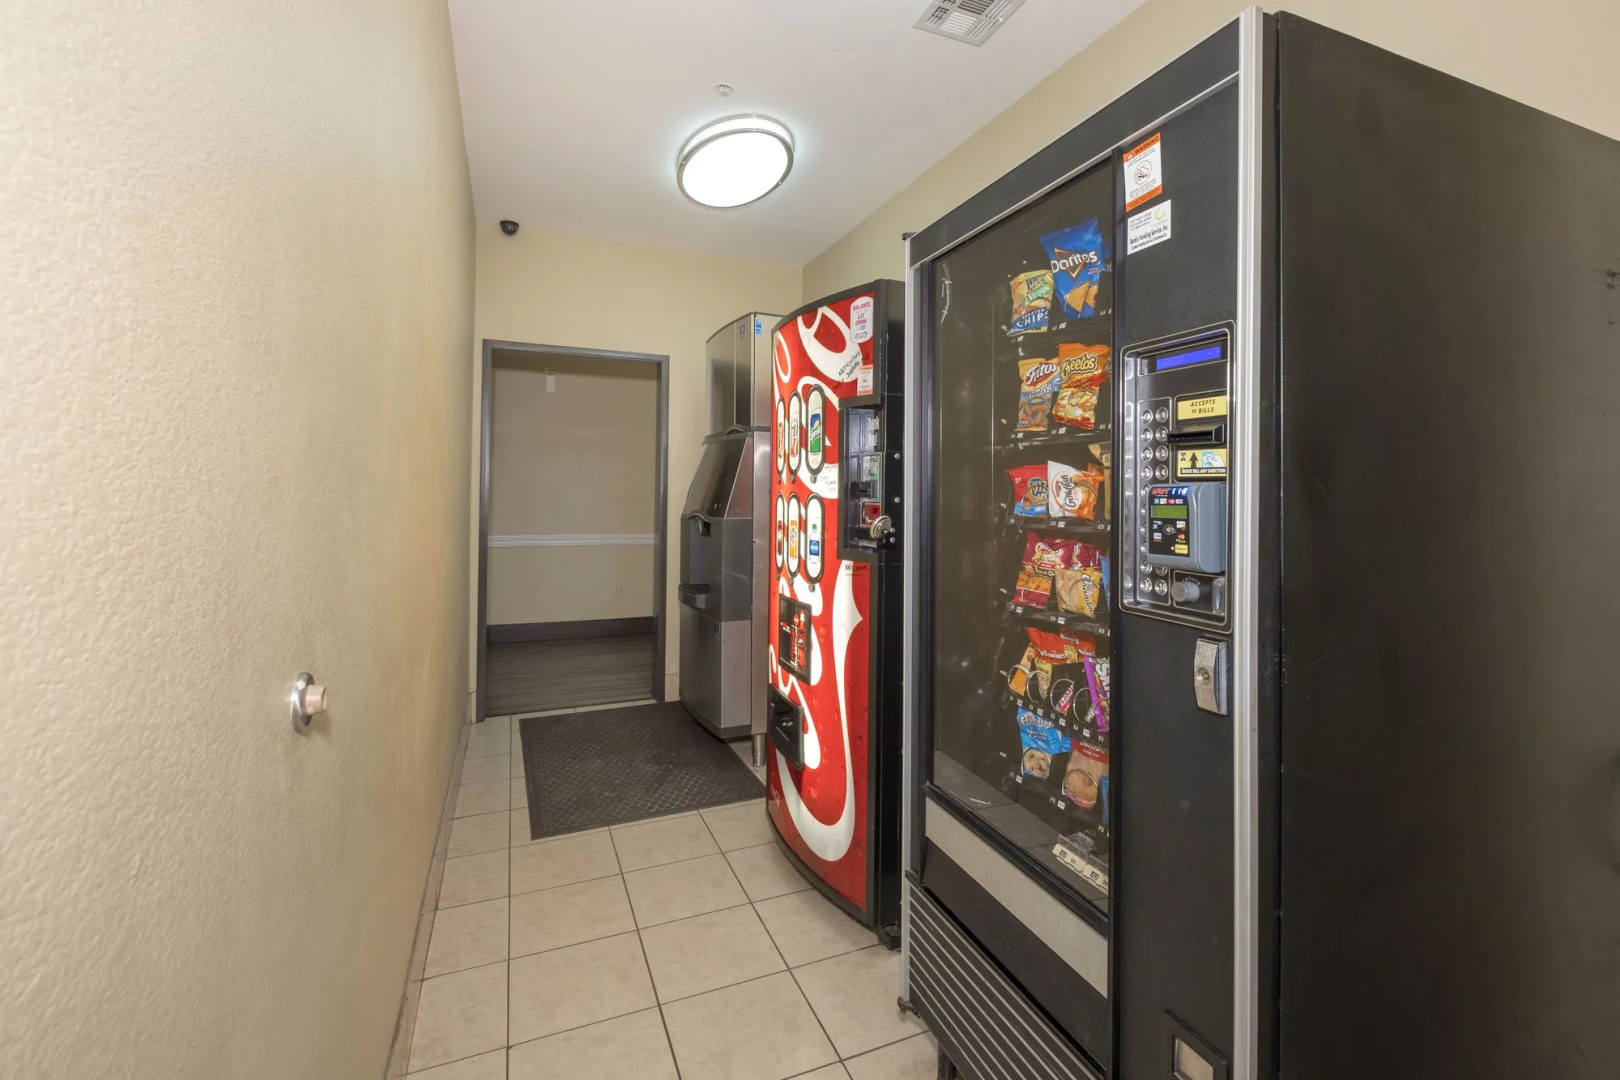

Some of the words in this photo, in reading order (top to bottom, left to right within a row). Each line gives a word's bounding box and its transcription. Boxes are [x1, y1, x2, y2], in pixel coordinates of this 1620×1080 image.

[1135, 136, 1159, 154] WARNING
[1050, 251, 1098, 273] Doritos
[1028, 284, 1051, 300] Veggie
[852, 301, 871, 311] BALANCE
[855, 319, 867, 327] DRINK
[857, 312, 865, 320] EAT
[1026, 363, 1057, 385] Fritos
[1061, 354, 1097, 381] Cheetos
[1191, 399, 1216, 407] ACCEPTS
[1061, 474, 1077, 508] Goldfish
